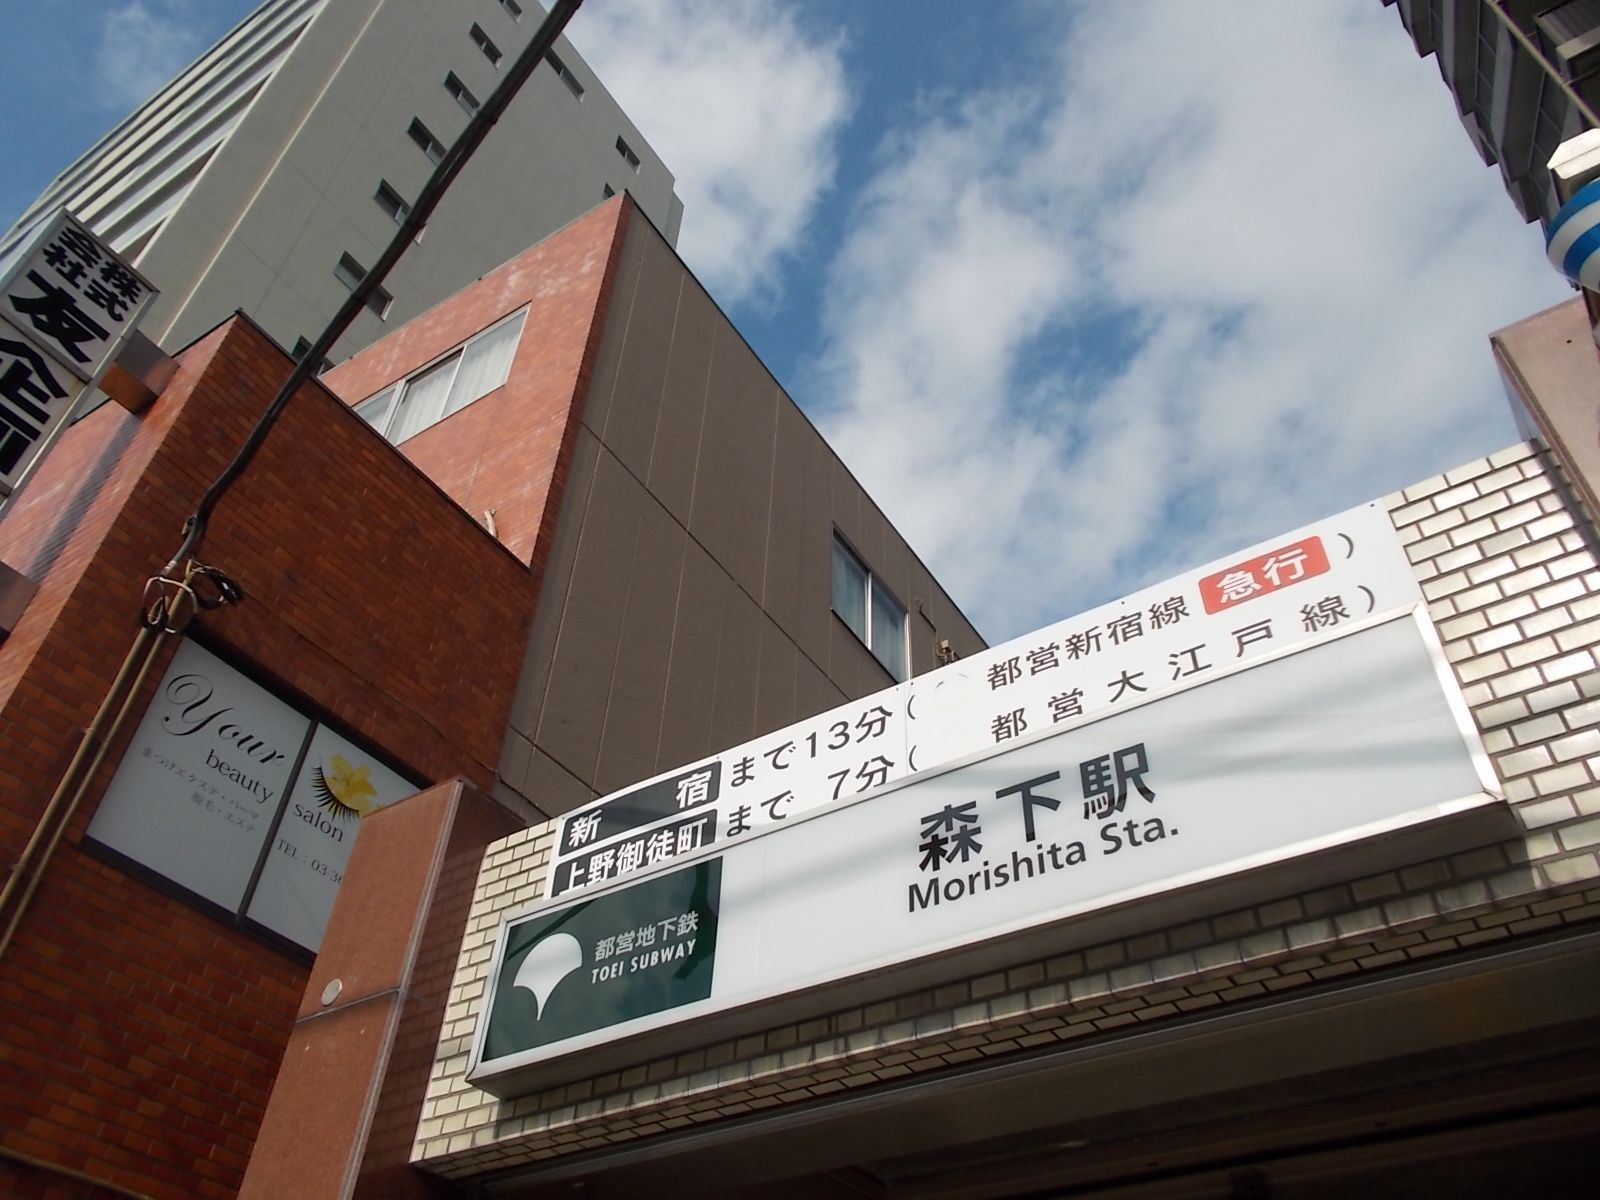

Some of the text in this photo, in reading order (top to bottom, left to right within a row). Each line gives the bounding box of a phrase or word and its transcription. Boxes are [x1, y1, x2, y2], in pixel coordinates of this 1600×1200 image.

[987, 595, 1191, 691] 都営新宿線
[1215, 547, 1309, 605] 急行
[162, 673, 286, 767] Your
[205, 749, 275, 804] beauty
[918, 742, 1156, 873] 森下駅
[293, 803, 345, 843] salon
[559, 817, 708, 894] 上野御徒町
[908, 812, 1179, 914] Morishita Sta.
[591, 938, 697, 985] TOEI SUBWAY
[593, 911, 699, 962] 都営地下鉄
